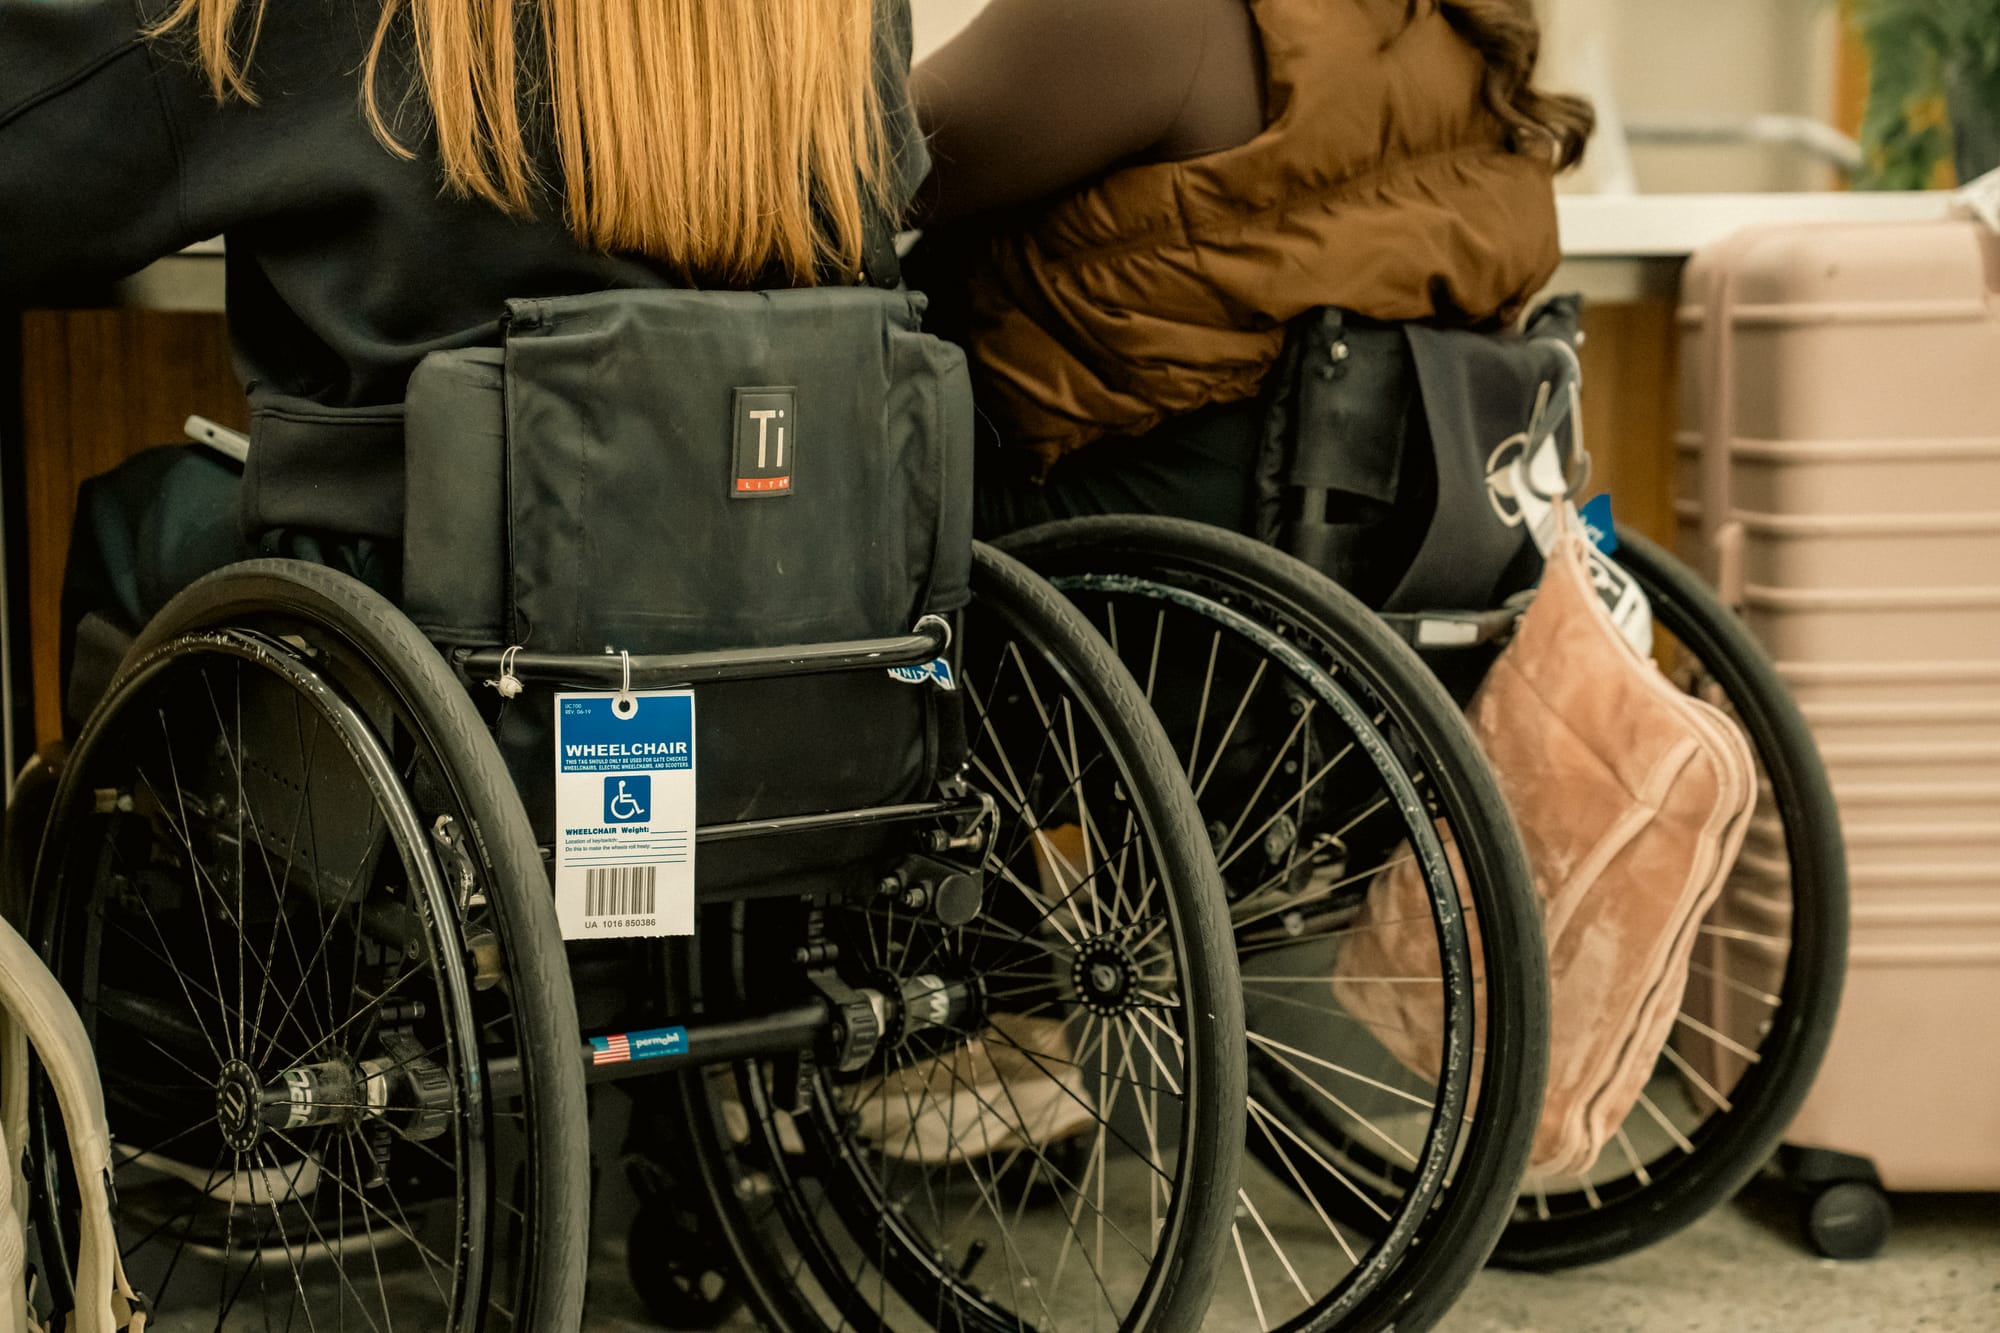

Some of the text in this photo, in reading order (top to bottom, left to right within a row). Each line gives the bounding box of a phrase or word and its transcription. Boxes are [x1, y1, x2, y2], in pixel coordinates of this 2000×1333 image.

[750, 410, 784, 468] Ti
[566, 742, 687, 757] WHEELCHAIR
[584, 918, 656, 929] UA 1016 850386
[636, 1032, 679, 1049] permobil
